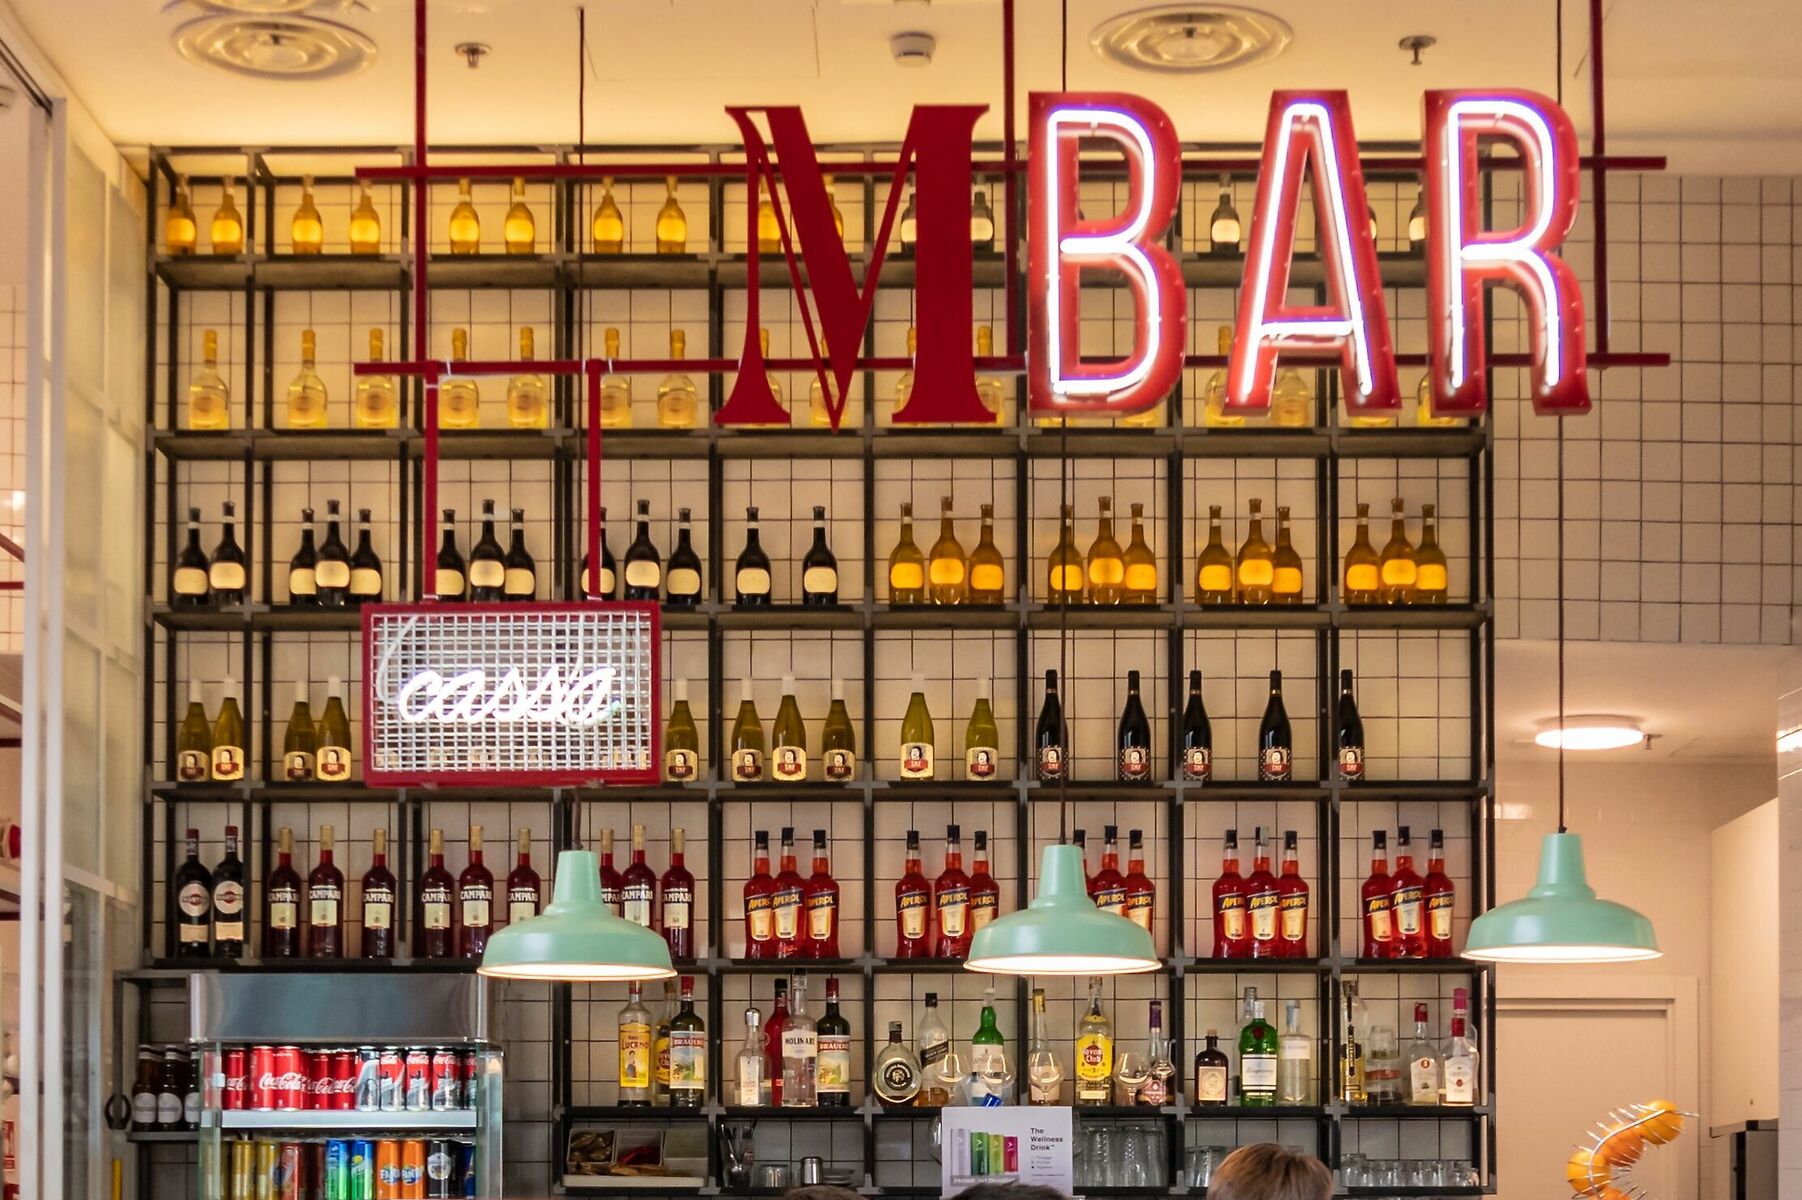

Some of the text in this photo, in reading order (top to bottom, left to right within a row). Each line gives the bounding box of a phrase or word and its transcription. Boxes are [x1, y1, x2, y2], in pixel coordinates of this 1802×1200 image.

[714, 88, 1592, 432] M BAR
[621, 889, 653, 900] CAMPARI
[784, 1037, 815, 1045] MOLINARI
[1030, 1127, 1045, 1135] The
